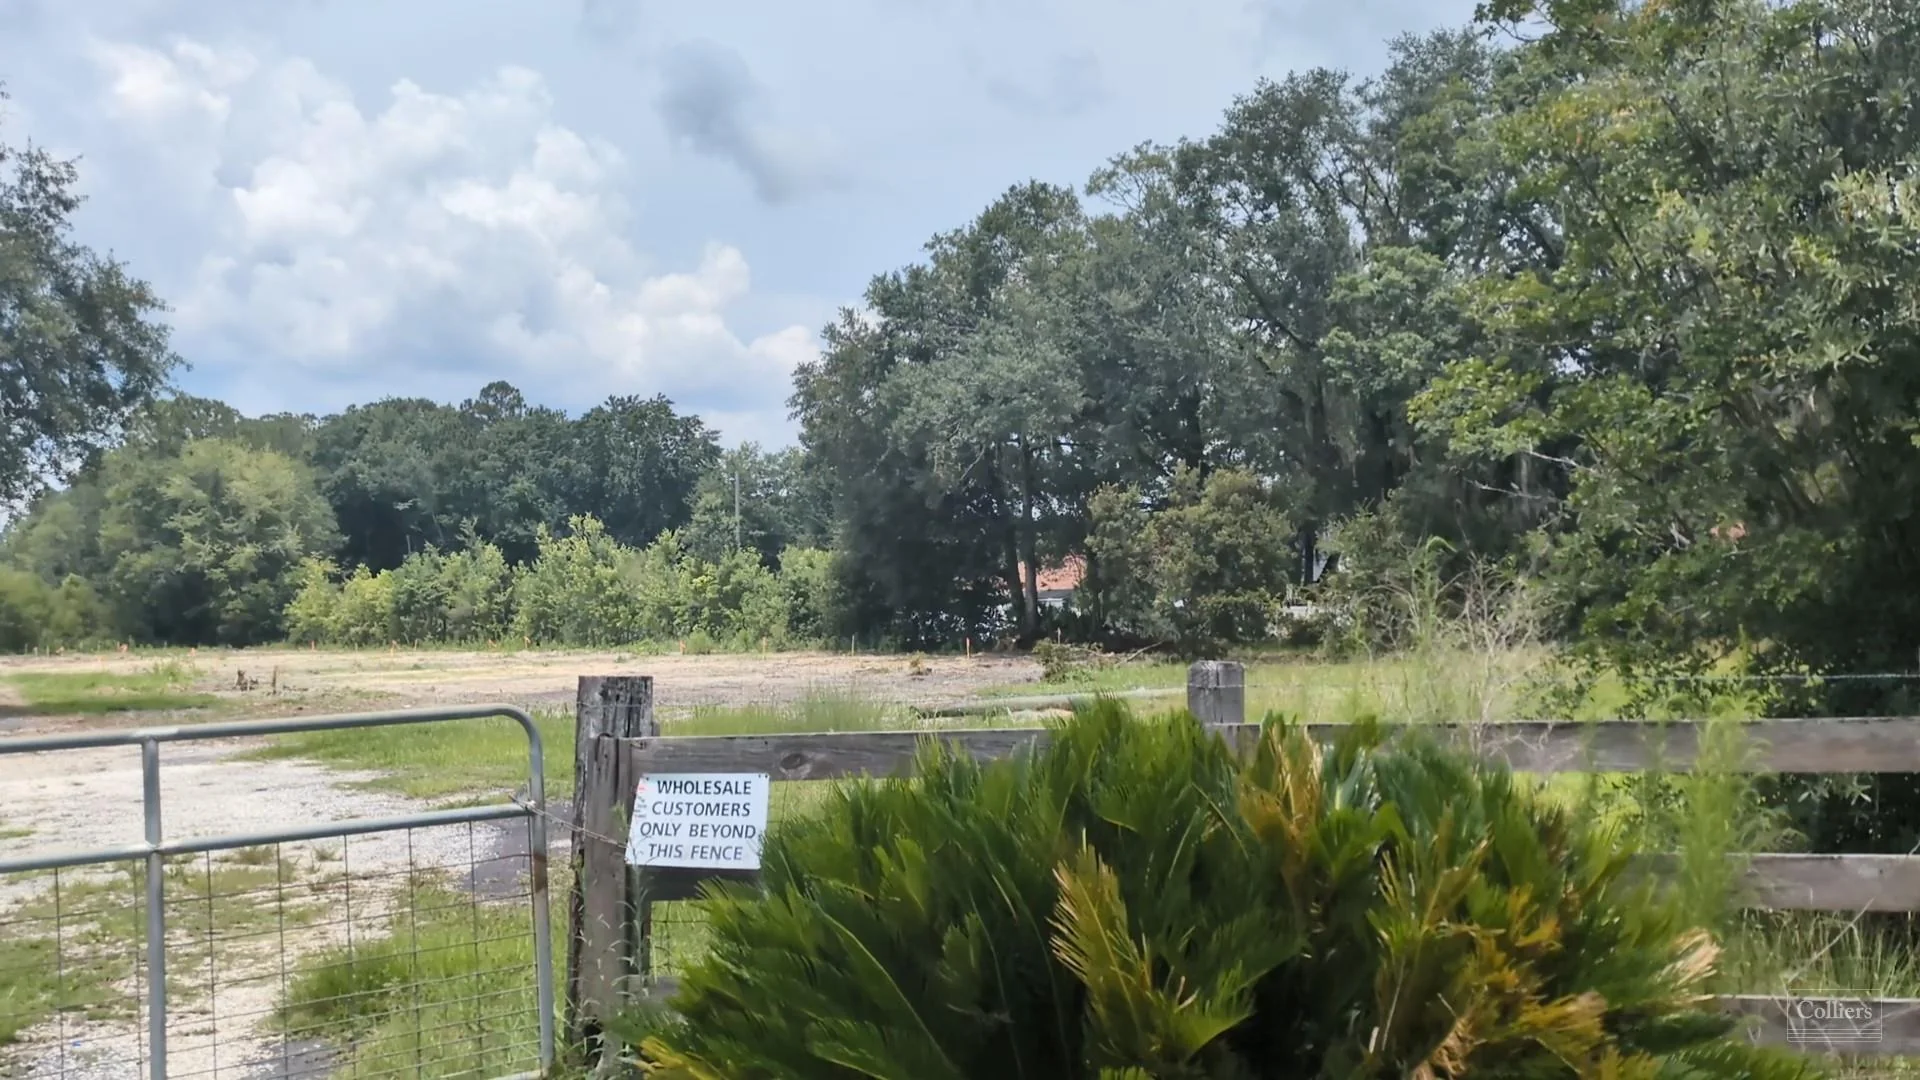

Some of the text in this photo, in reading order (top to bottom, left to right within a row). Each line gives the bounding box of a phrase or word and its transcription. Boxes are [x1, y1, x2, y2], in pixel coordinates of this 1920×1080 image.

[657, 780, 752, 795] WHOLESALE
[652, 801, 751, 817] CUSTOMERS
[640, 822, 756, 839] ONLY BEYOND
[649, 843, 743, 860] THIS FENCE
